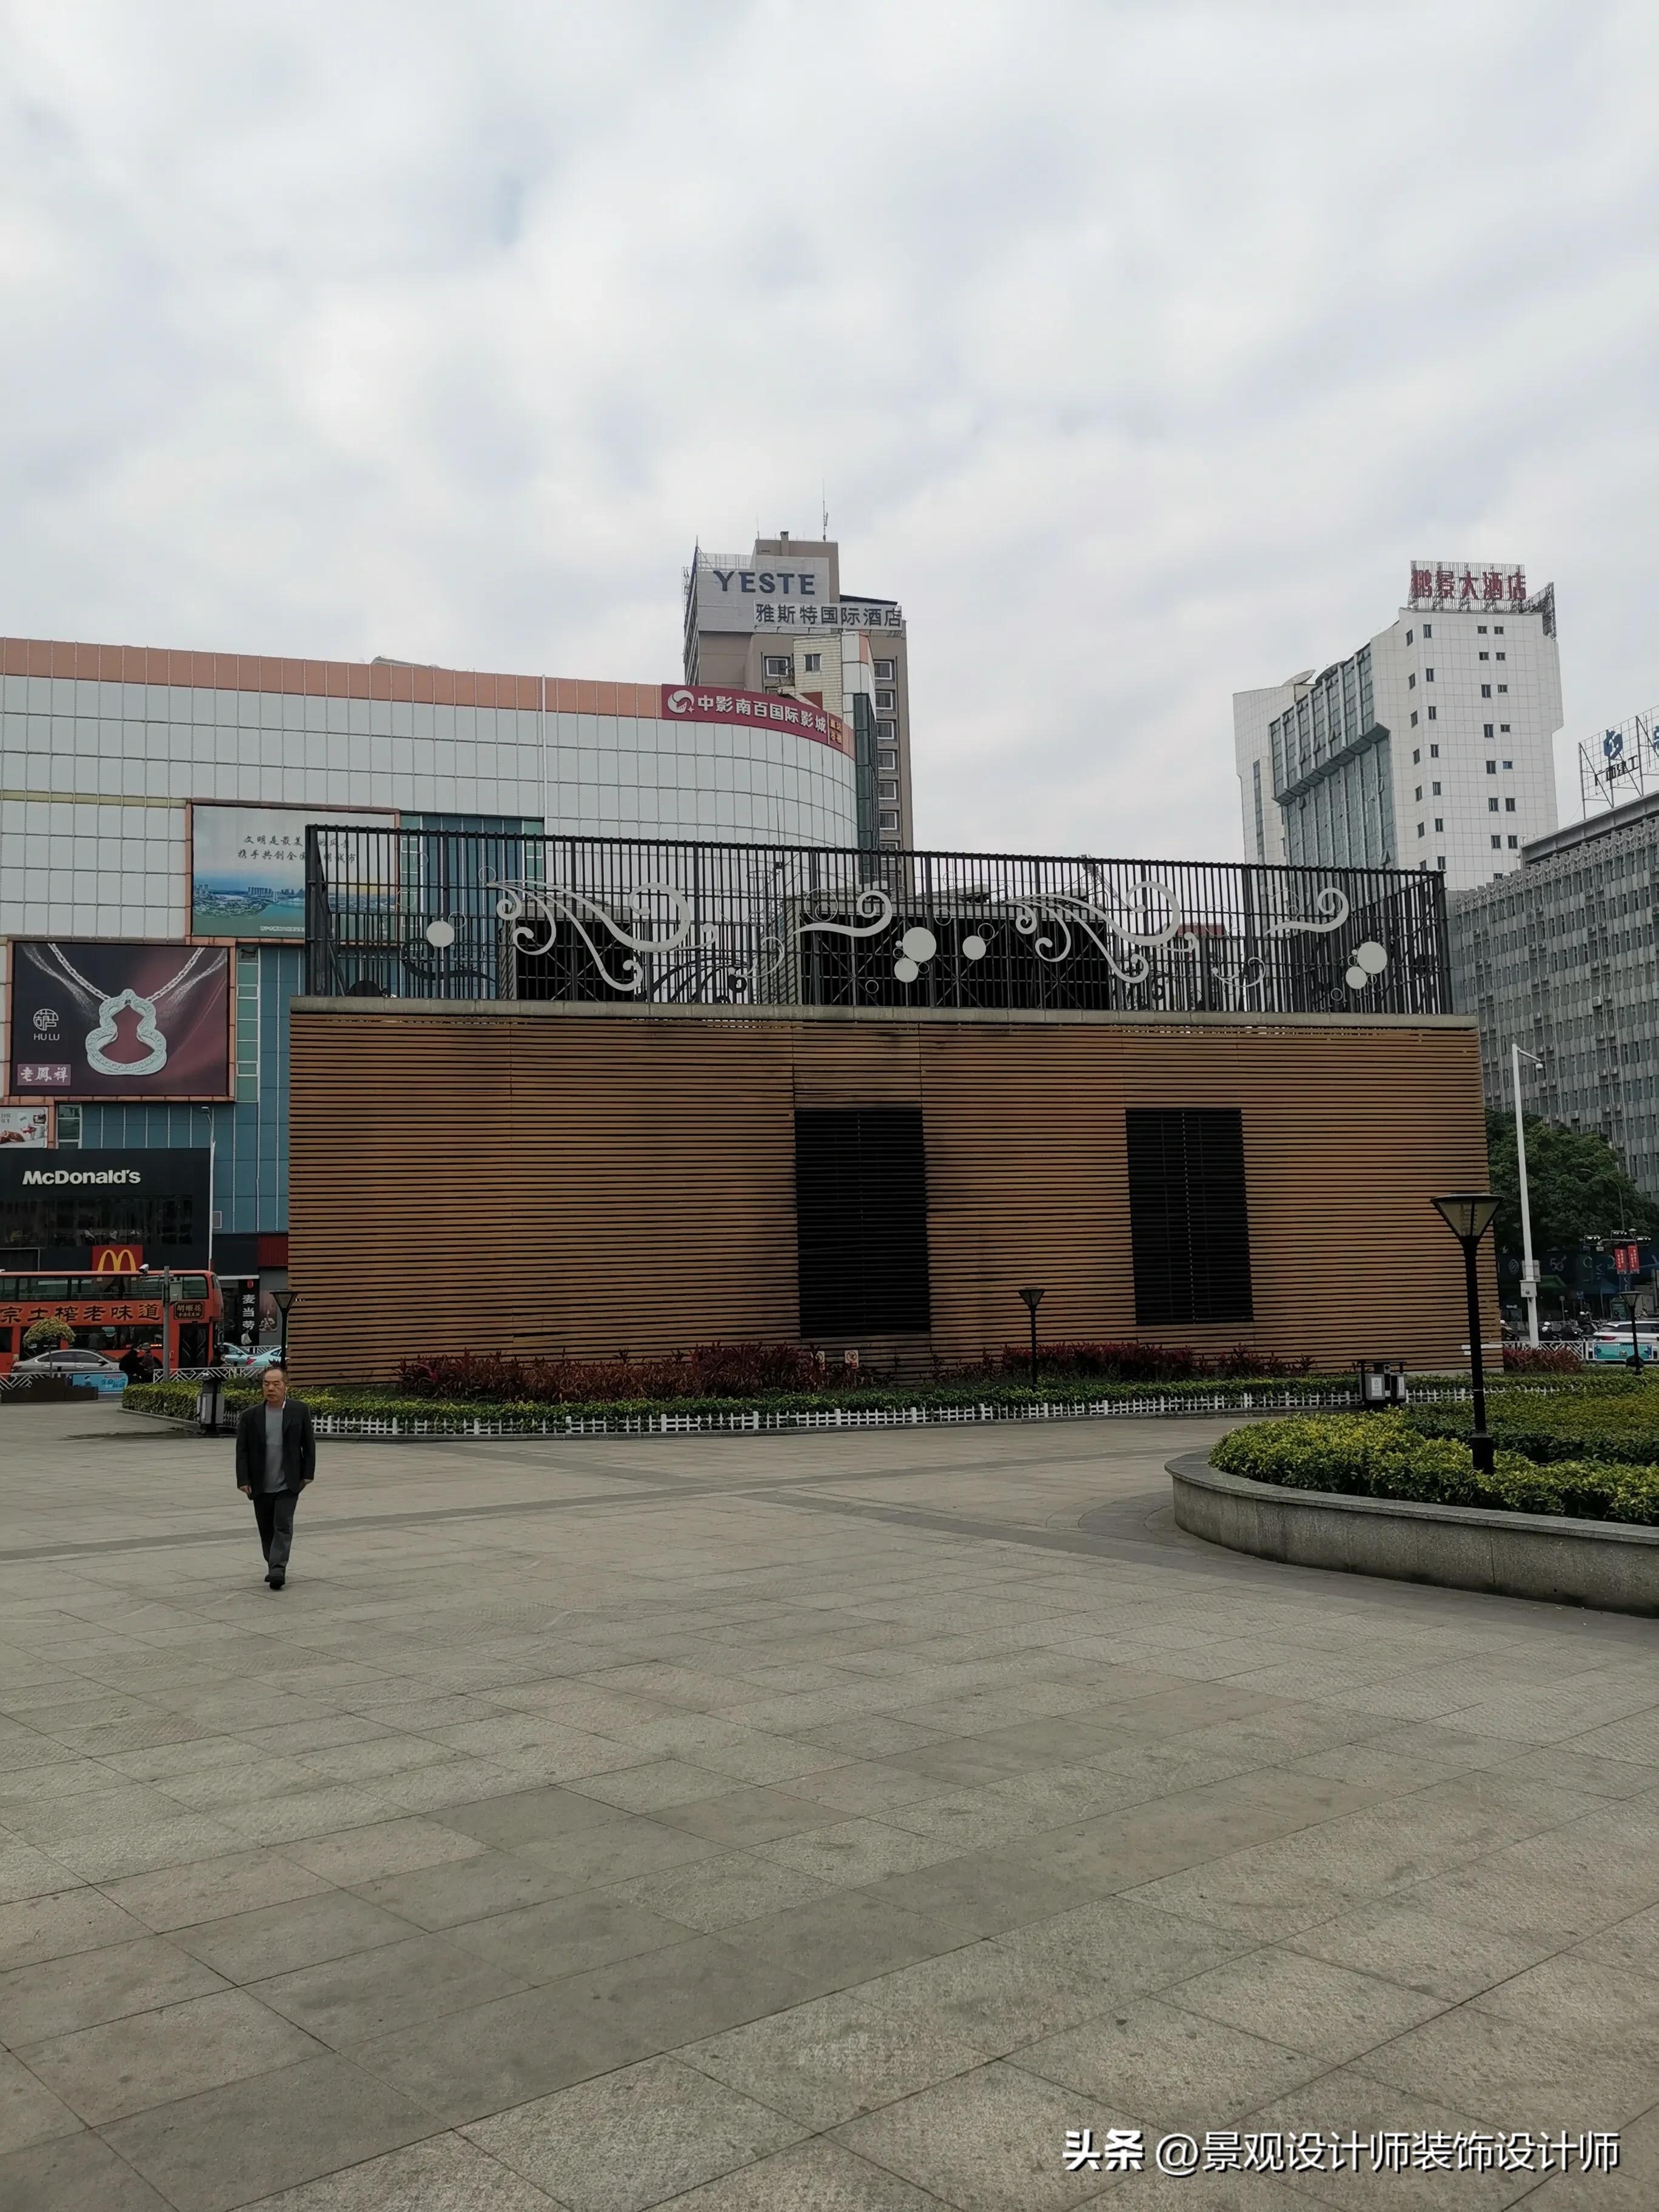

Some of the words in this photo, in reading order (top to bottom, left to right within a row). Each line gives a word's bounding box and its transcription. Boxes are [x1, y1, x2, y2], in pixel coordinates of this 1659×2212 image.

[713, 571, 816, 595] YESTE
[1412, 569, 1526, 600] 鹏景大酒店
[756, 604, 902, 627] 雅斯特国际酒店
[698, 695, 827, 734] 中影南百国际影城
[244, 835, 350, 848] 文明是最美的风景
[238, 849, 357, 863] 携手共创全国明城市
[22, 1170, 141, 1185] McDonald's
[243, 1294, 255, 1330] 麦当劳
